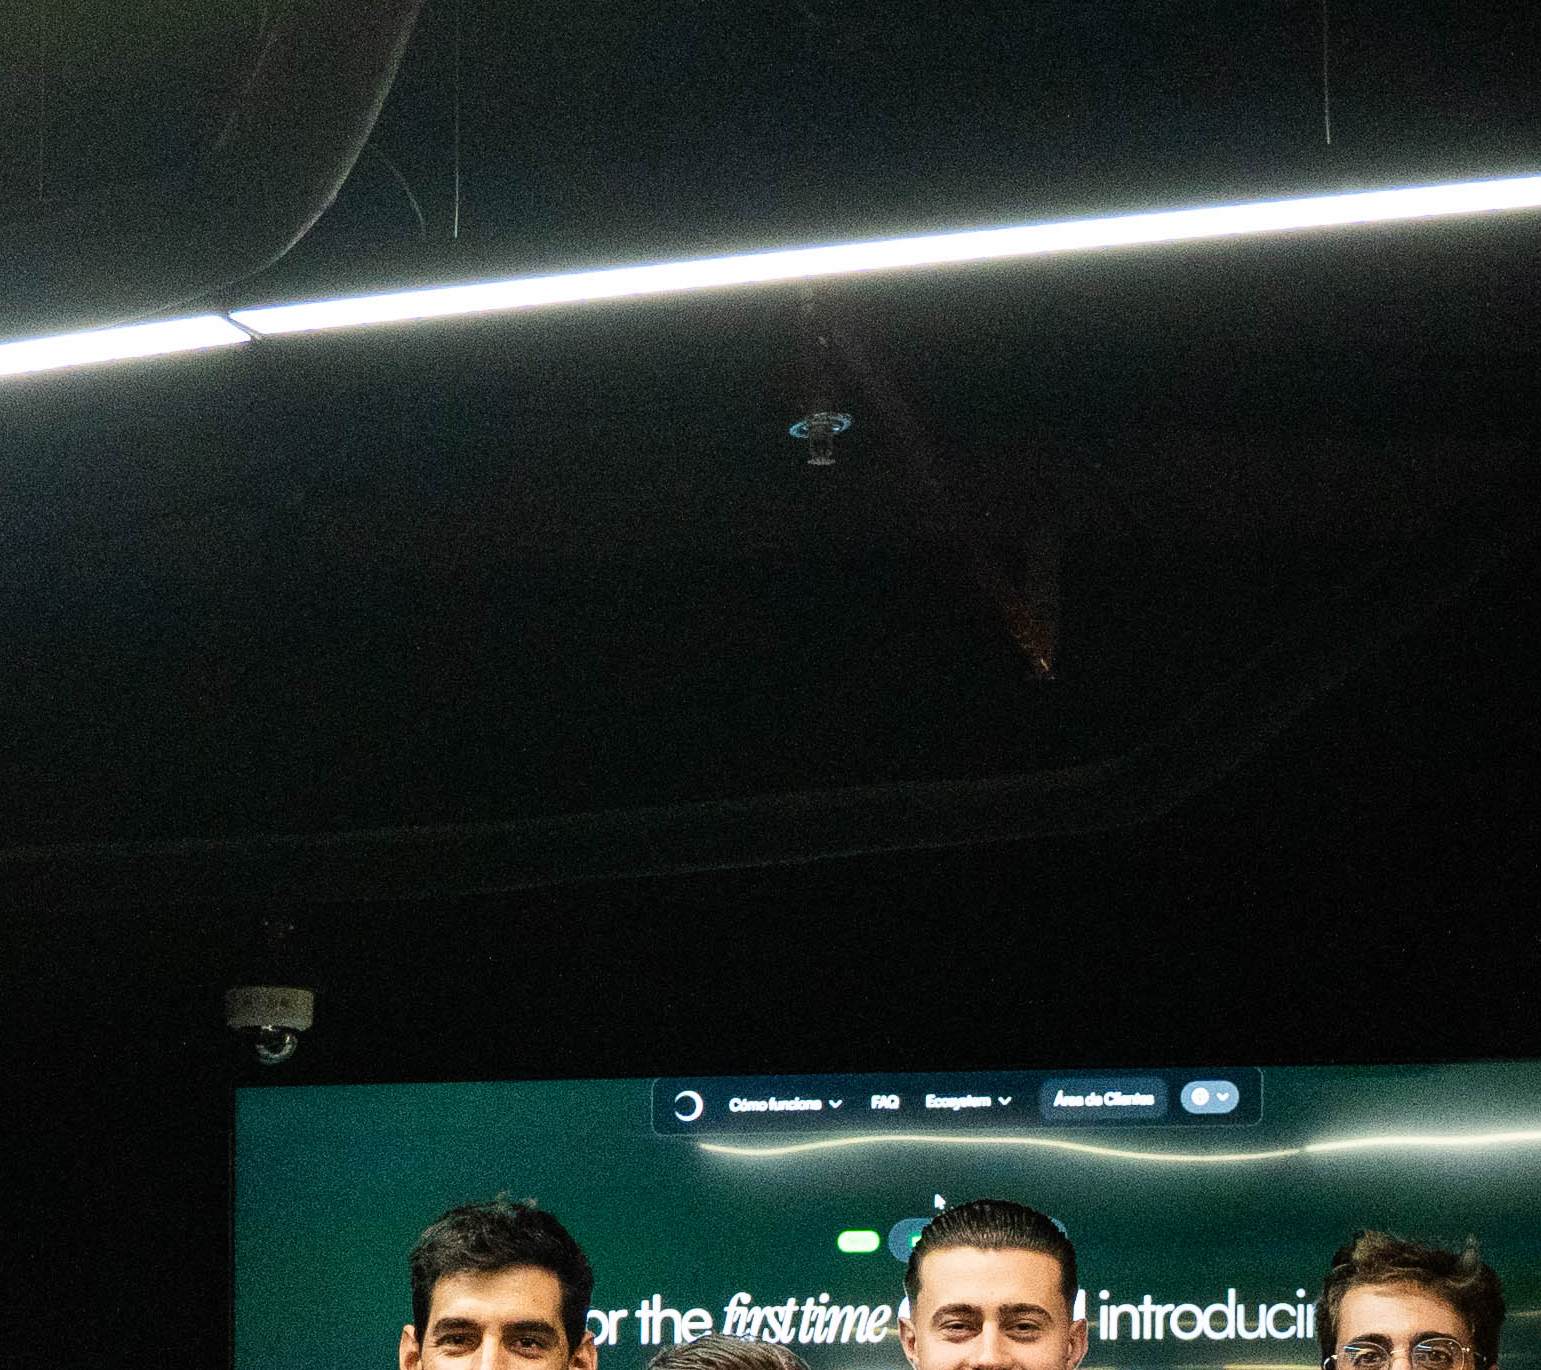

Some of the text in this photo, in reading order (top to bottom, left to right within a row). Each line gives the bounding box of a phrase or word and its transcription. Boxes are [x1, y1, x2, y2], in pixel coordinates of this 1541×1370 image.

[871, 1094, 900, 1109] FAQ
[925, 1093, 992, 1111] Ecosystem
[1084, 1092, 1103, 1107] de
[1104, 1091, 1155, 1106] Clientes
[586, 1309, 628, 1345] or
[635, 1293, 713, 1345] the
[723, 1292, 799, 1343] first
[799, 1293, 892, 1343] time
